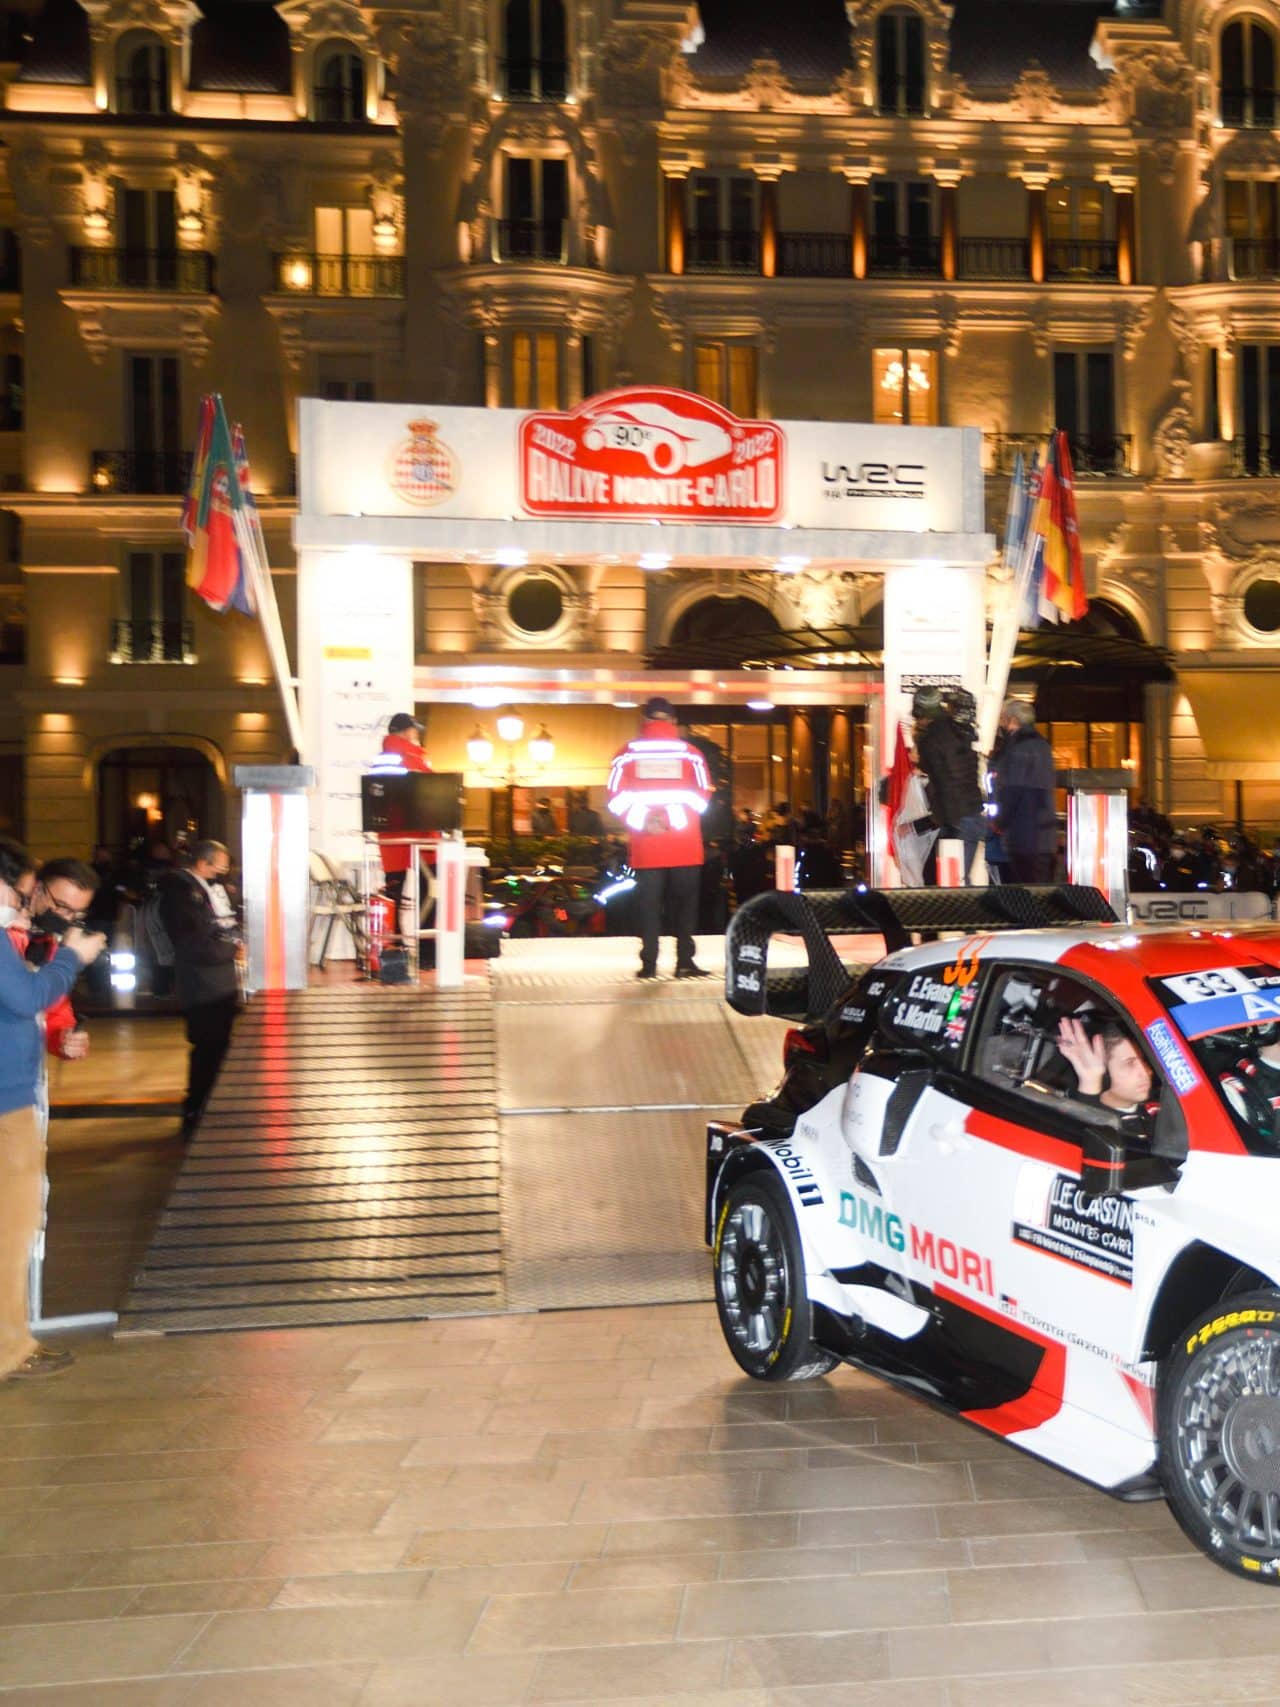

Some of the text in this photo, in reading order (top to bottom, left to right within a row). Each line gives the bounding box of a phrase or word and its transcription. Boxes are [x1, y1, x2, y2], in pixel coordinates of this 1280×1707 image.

[527, 447, 609, 504] RALLYE
[821, 462, 925, 486] WRC
[1184, 972, 1237, 998] 33
[764, 1139, 814, 1181] Mobil
[836, 1188, 995, 1298] DMG MORI
